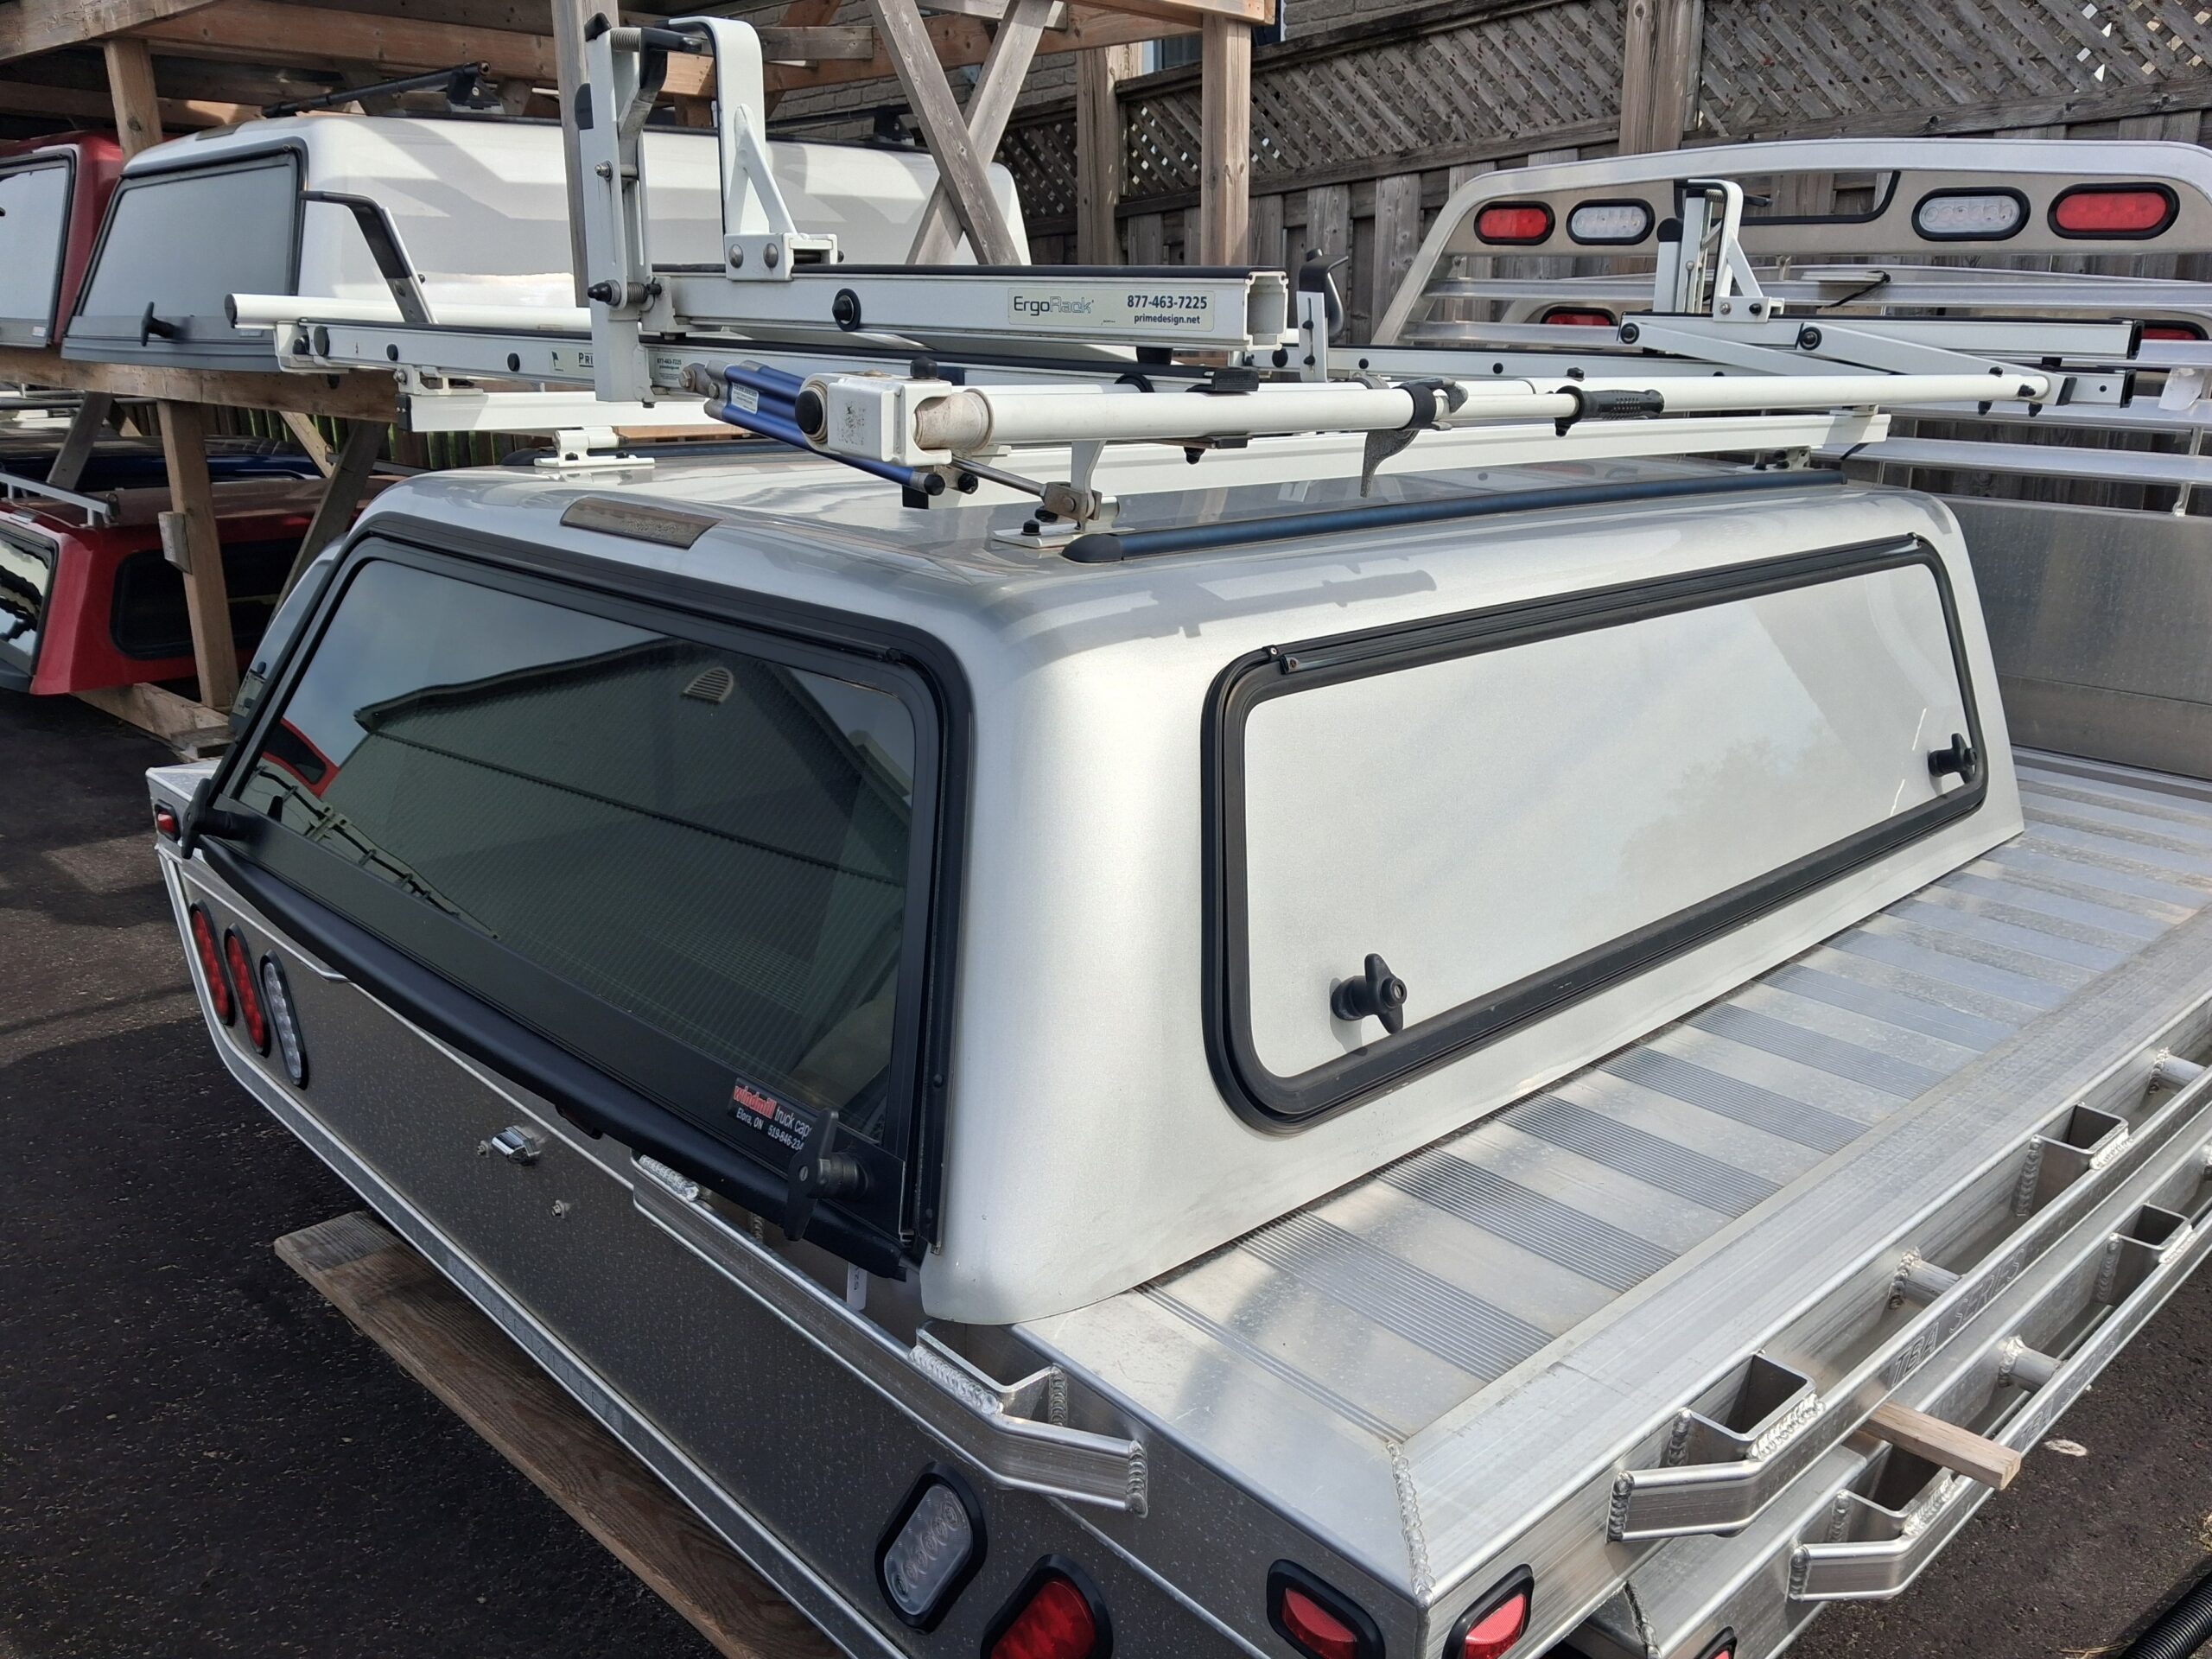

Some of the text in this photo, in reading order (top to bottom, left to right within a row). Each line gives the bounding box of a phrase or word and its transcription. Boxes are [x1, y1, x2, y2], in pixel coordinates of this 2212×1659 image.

[1014, 295, 1208, 316] ErgoRack 877-463-7225
[1134, 313, 1200, 325] primedesign.net
[733, 1085, 778, 1120] windmill
[774, 1106, 795, 1130] truck
[736, 1108, 753, 1127] Elora,
[753, 1116, 765, 1131] ON
[1949, 1247, 2026, 1334] SERIES
